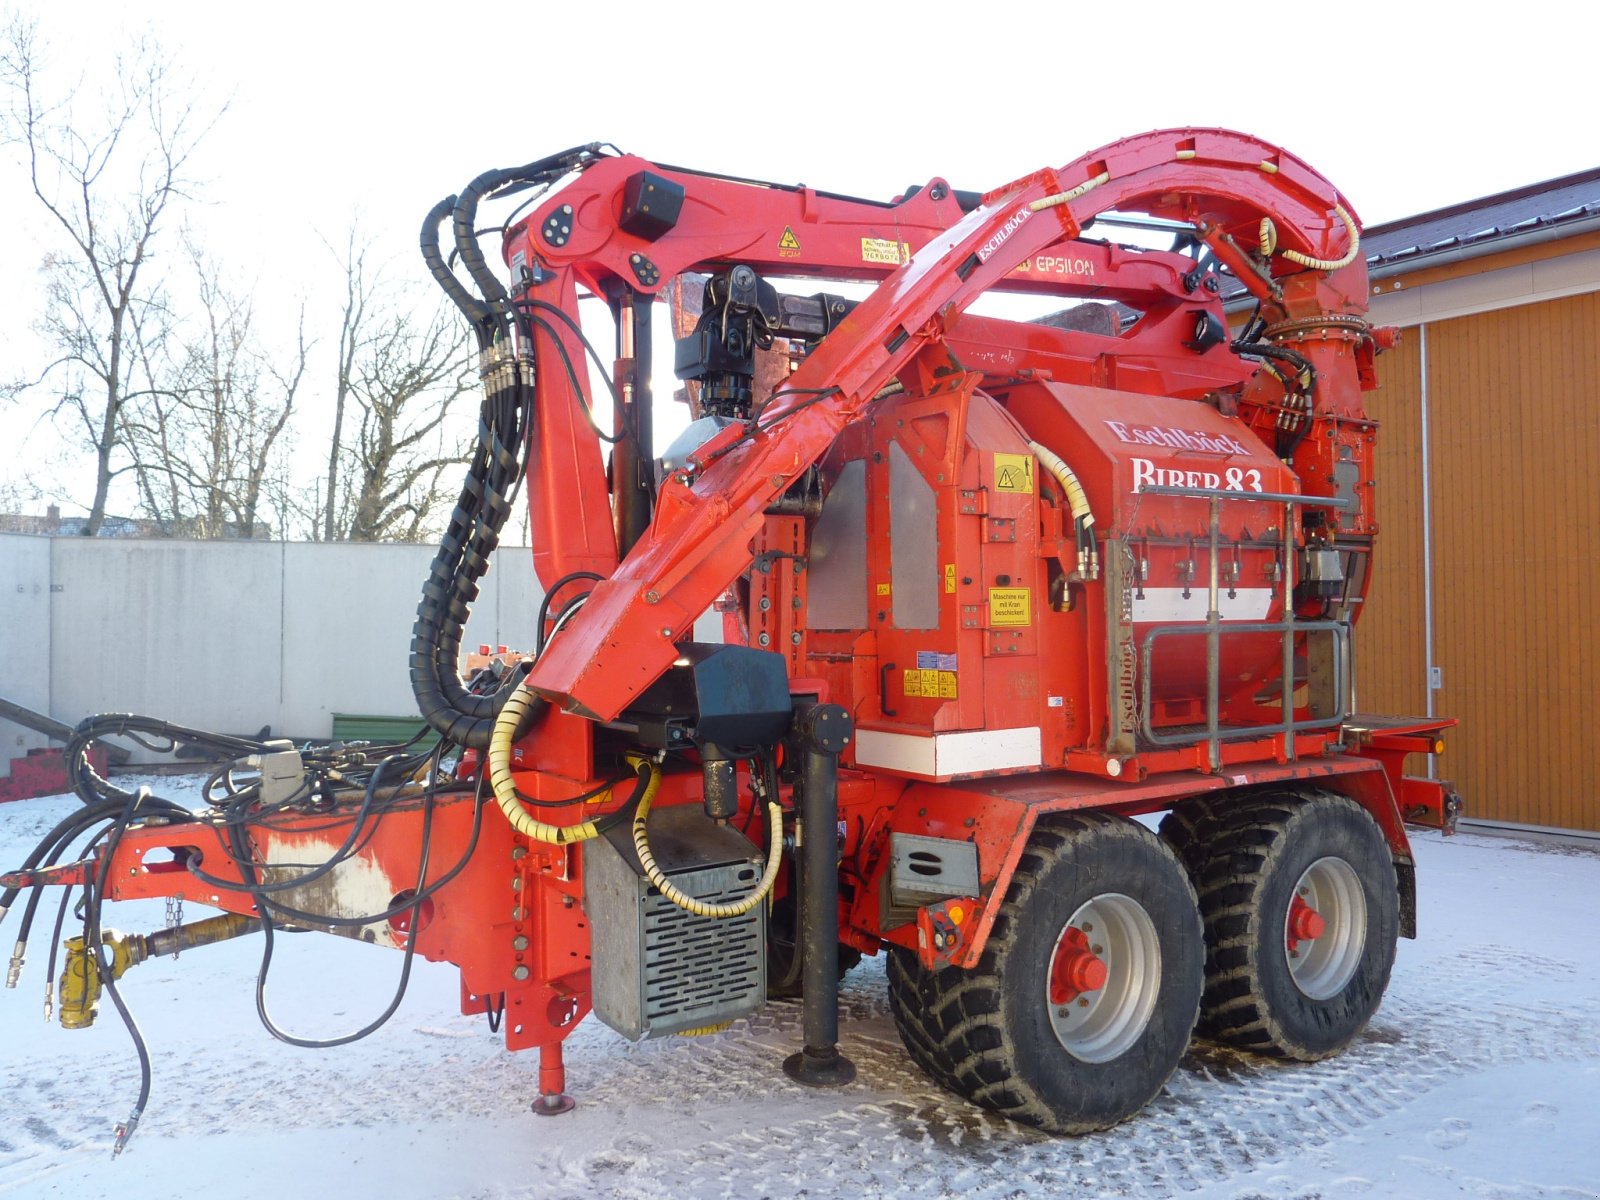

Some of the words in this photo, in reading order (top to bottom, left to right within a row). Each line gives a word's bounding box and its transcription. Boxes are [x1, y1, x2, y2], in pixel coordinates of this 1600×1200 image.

[978, 207, 1031, 261] ESCHLBÖCK
[1036, 256, 1095, 276] EPSILON
[1103, 420, 1252, 456] Eschlböck
[1225, 467, 1263, 502] 83
